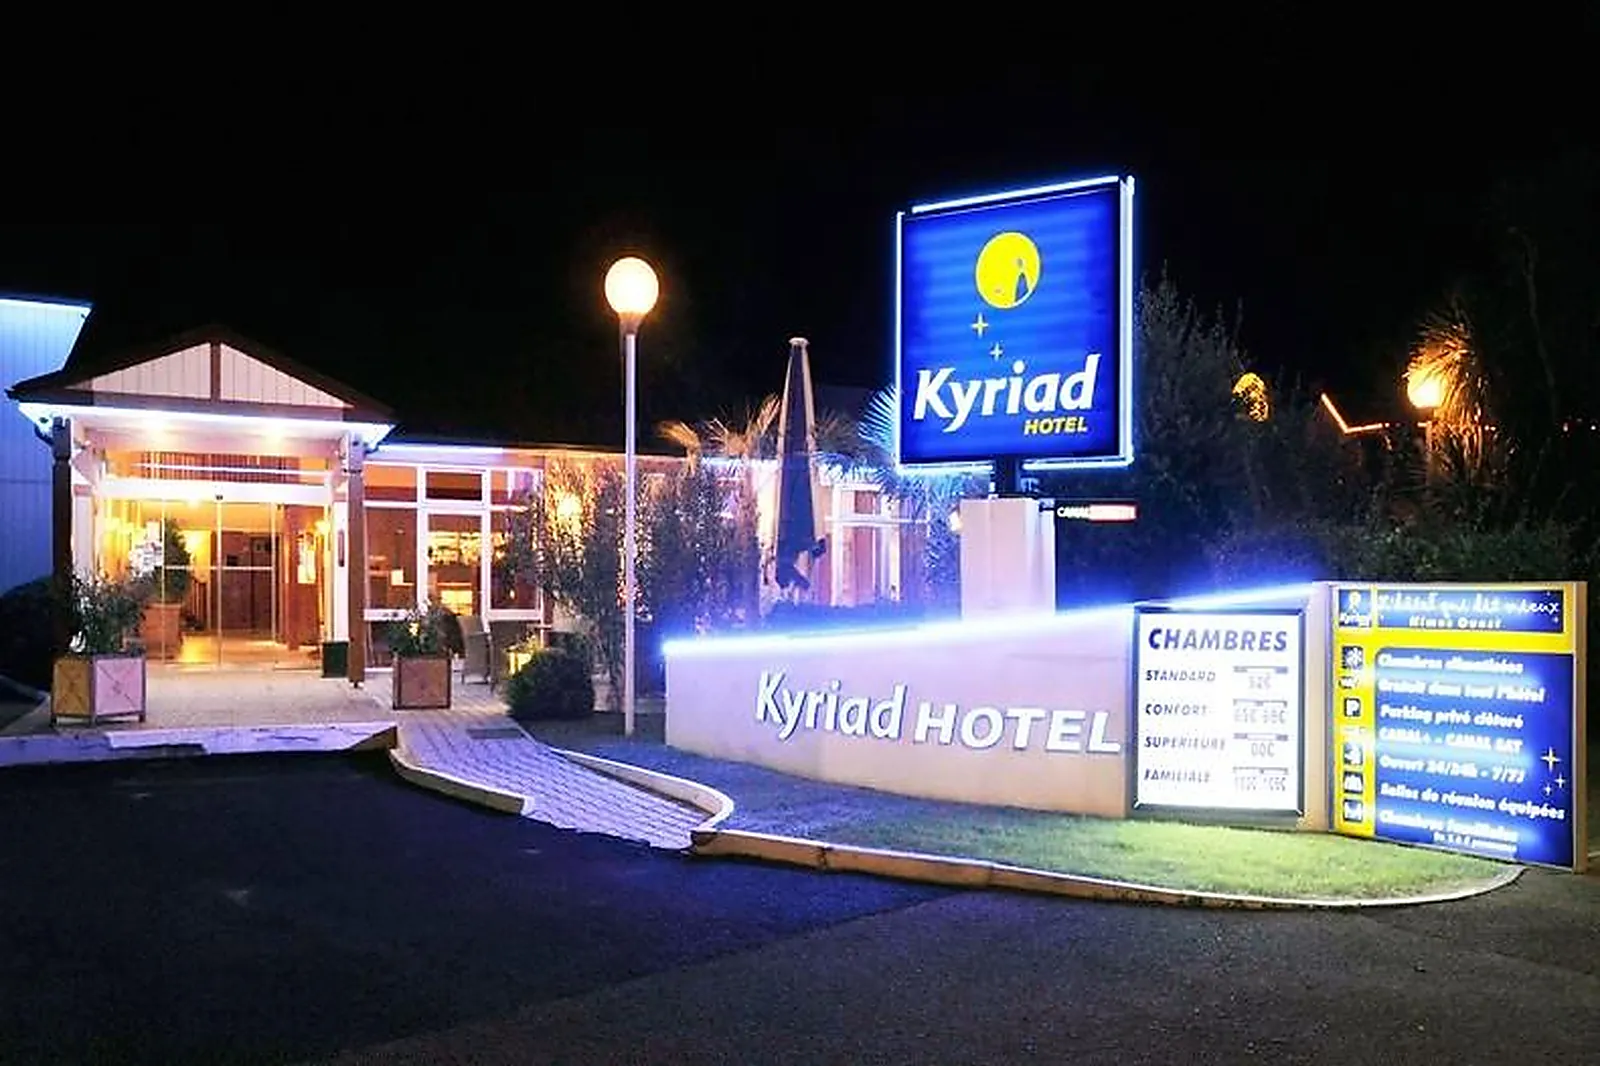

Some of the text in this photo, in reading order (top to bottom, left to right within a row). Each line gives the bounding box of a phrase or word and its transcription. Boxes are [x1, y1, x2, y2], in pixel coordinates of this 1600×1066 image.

[913, 354, 1101, 432] Kyriad
[1024, 416, 1087, 435] HOTEL
[1148, 628, 1288, 651] CHAMBRES
[1145, 669, 1216, 683] STANDARD
[755, 668, 1121, 753] Kyriad HOTEL
[1145, 703, 1207, 717] CONFORT
[1381, 705, 1430, 724] Parking
[1435, 709, 1471, 726] privé
[1381, 782, 1565, 820] Salles de réunion équipées
